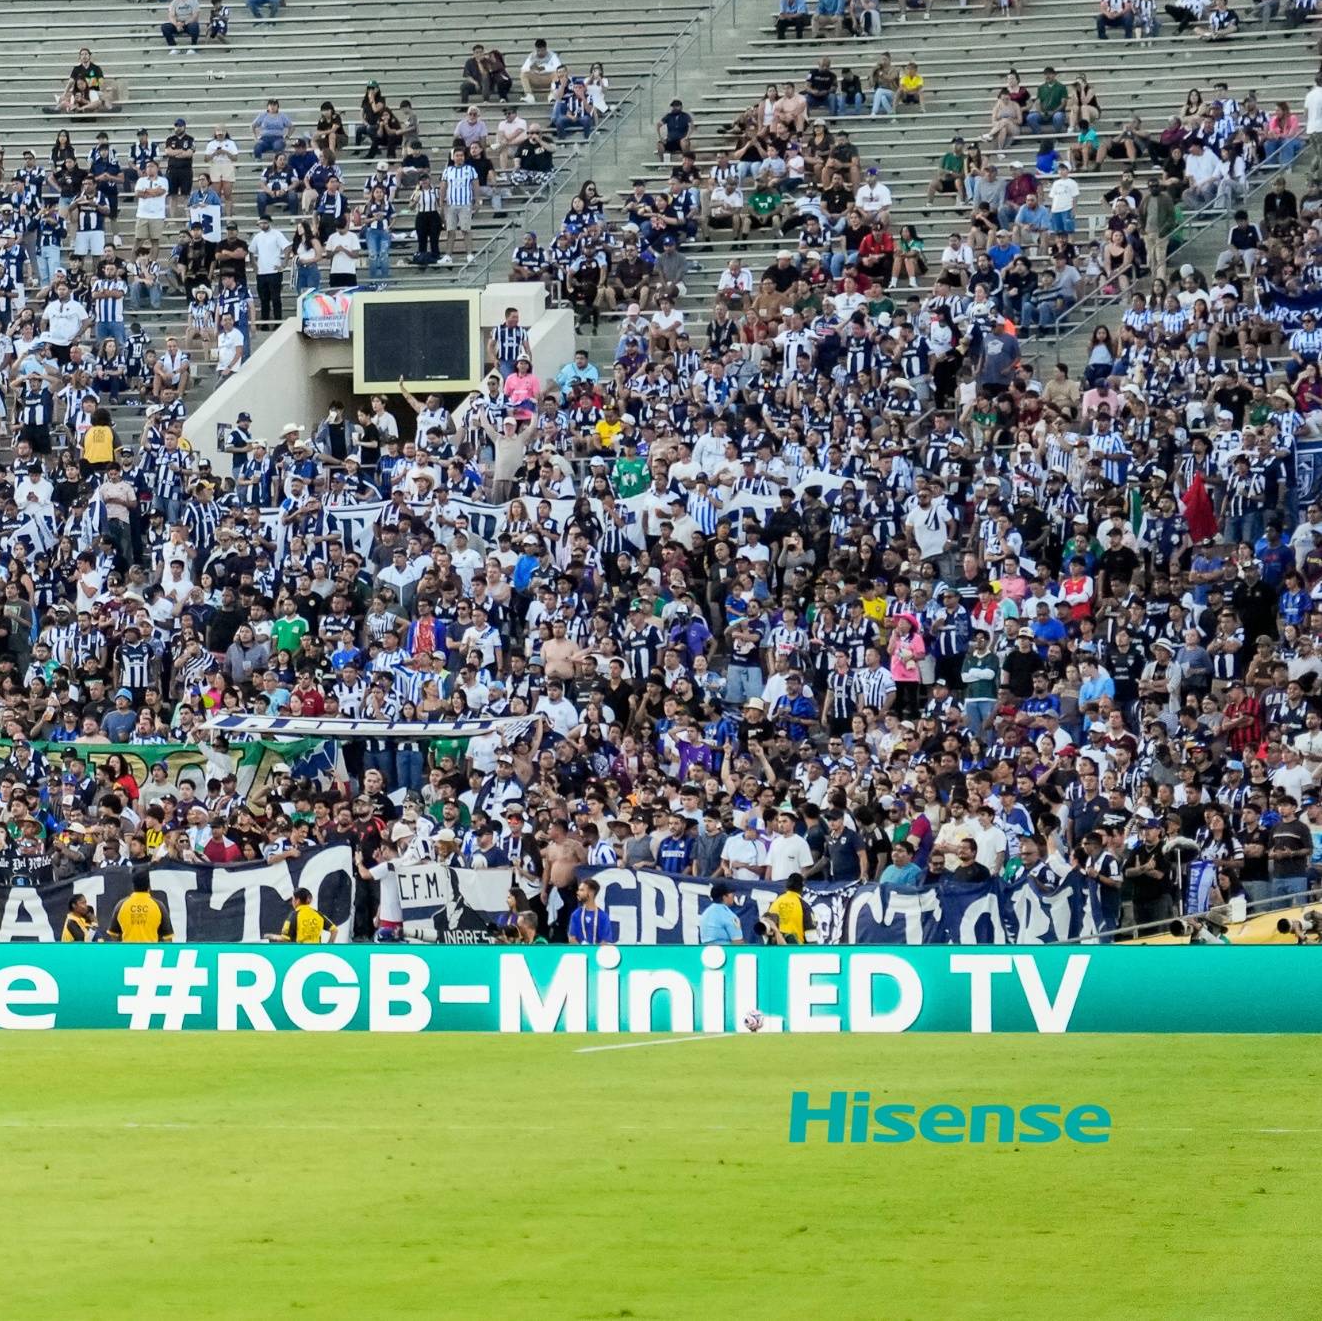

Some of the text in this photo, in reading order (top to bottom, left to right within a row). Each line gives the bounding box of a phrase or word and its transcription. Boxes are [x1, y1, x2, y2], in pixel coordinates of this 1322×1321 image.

[398, 873, 444, 901] C.F.M.
[130, 905, 149, 913] CSC
[442, 929, 492, 945] INARES
[117, 945, 924, 1033] #RGB-MiniLED
[950, 954, 1092, 1033] TV
